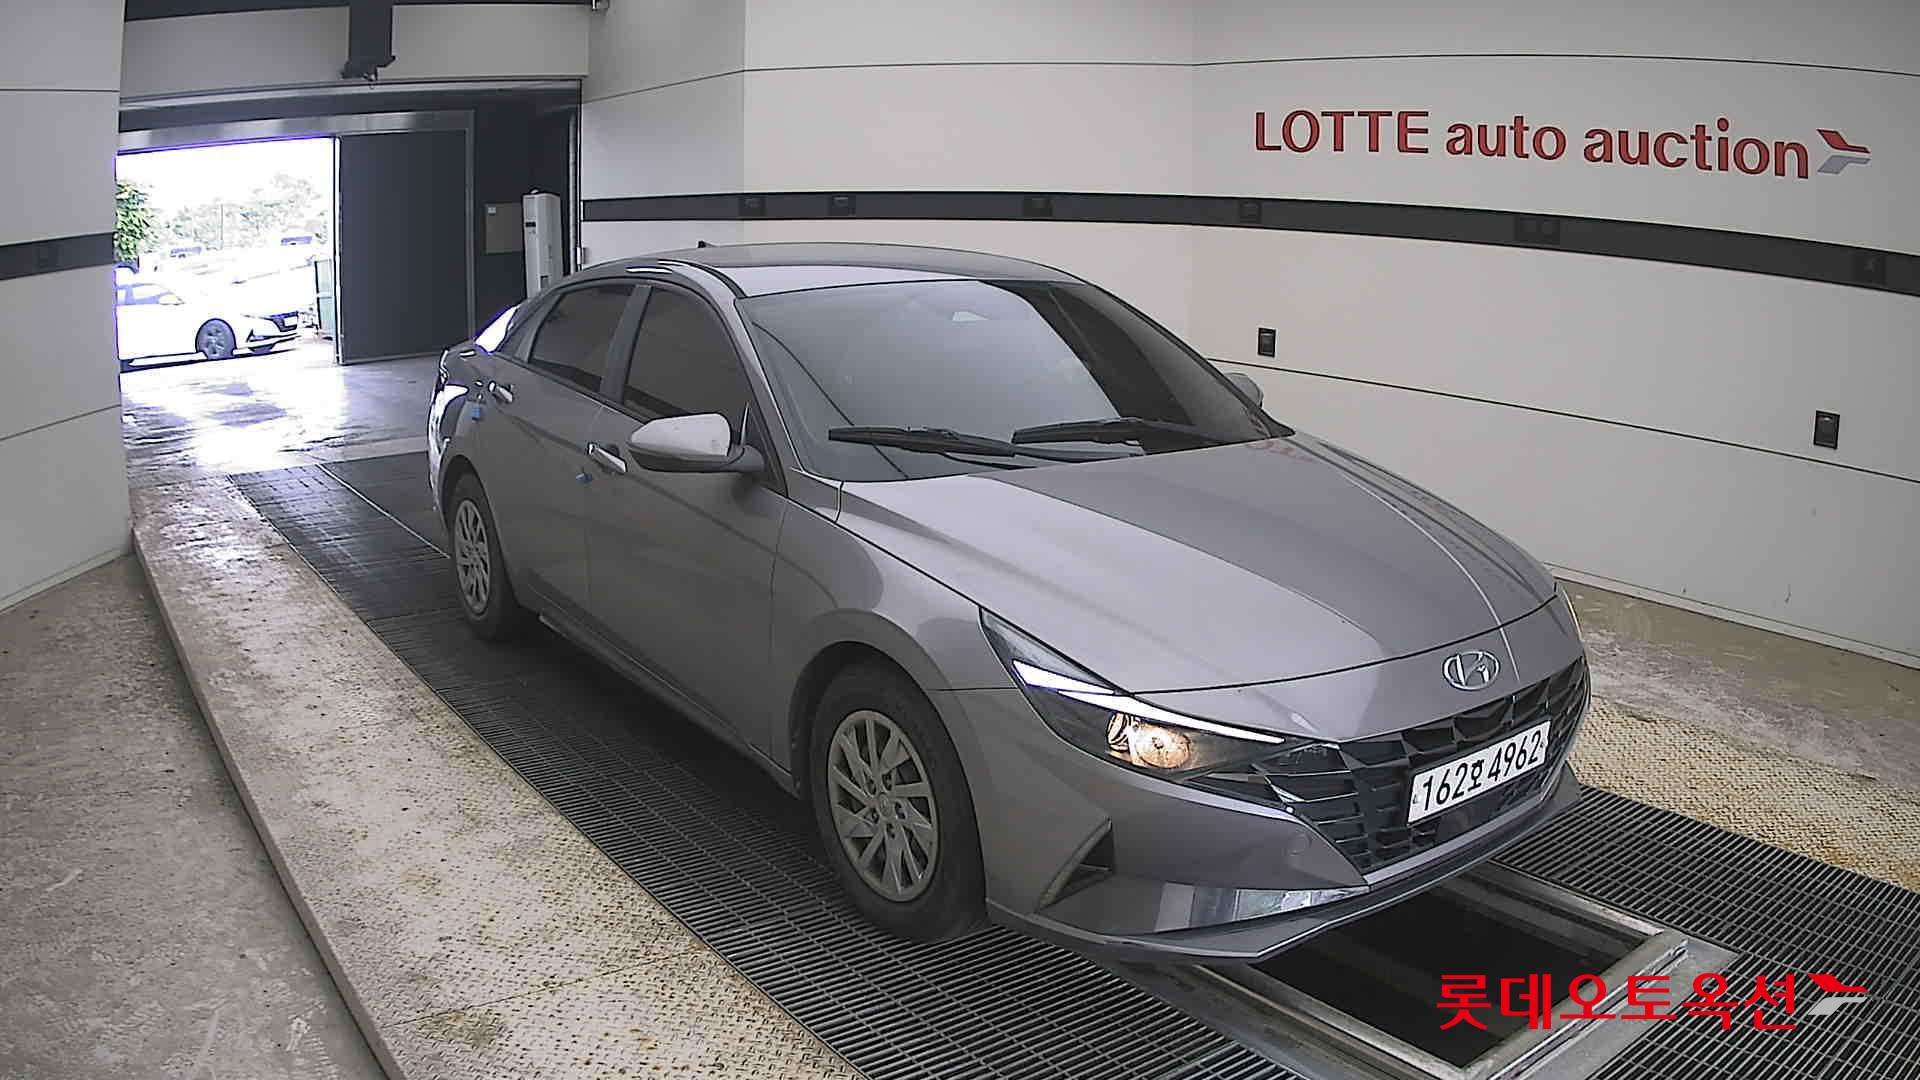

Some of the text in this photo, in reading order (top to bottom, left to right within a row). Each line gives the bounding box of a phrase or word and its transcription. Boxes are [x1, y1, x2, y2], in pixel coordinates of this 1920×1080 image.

[1254, 110, 1810, 180] LOTTE auto auction
